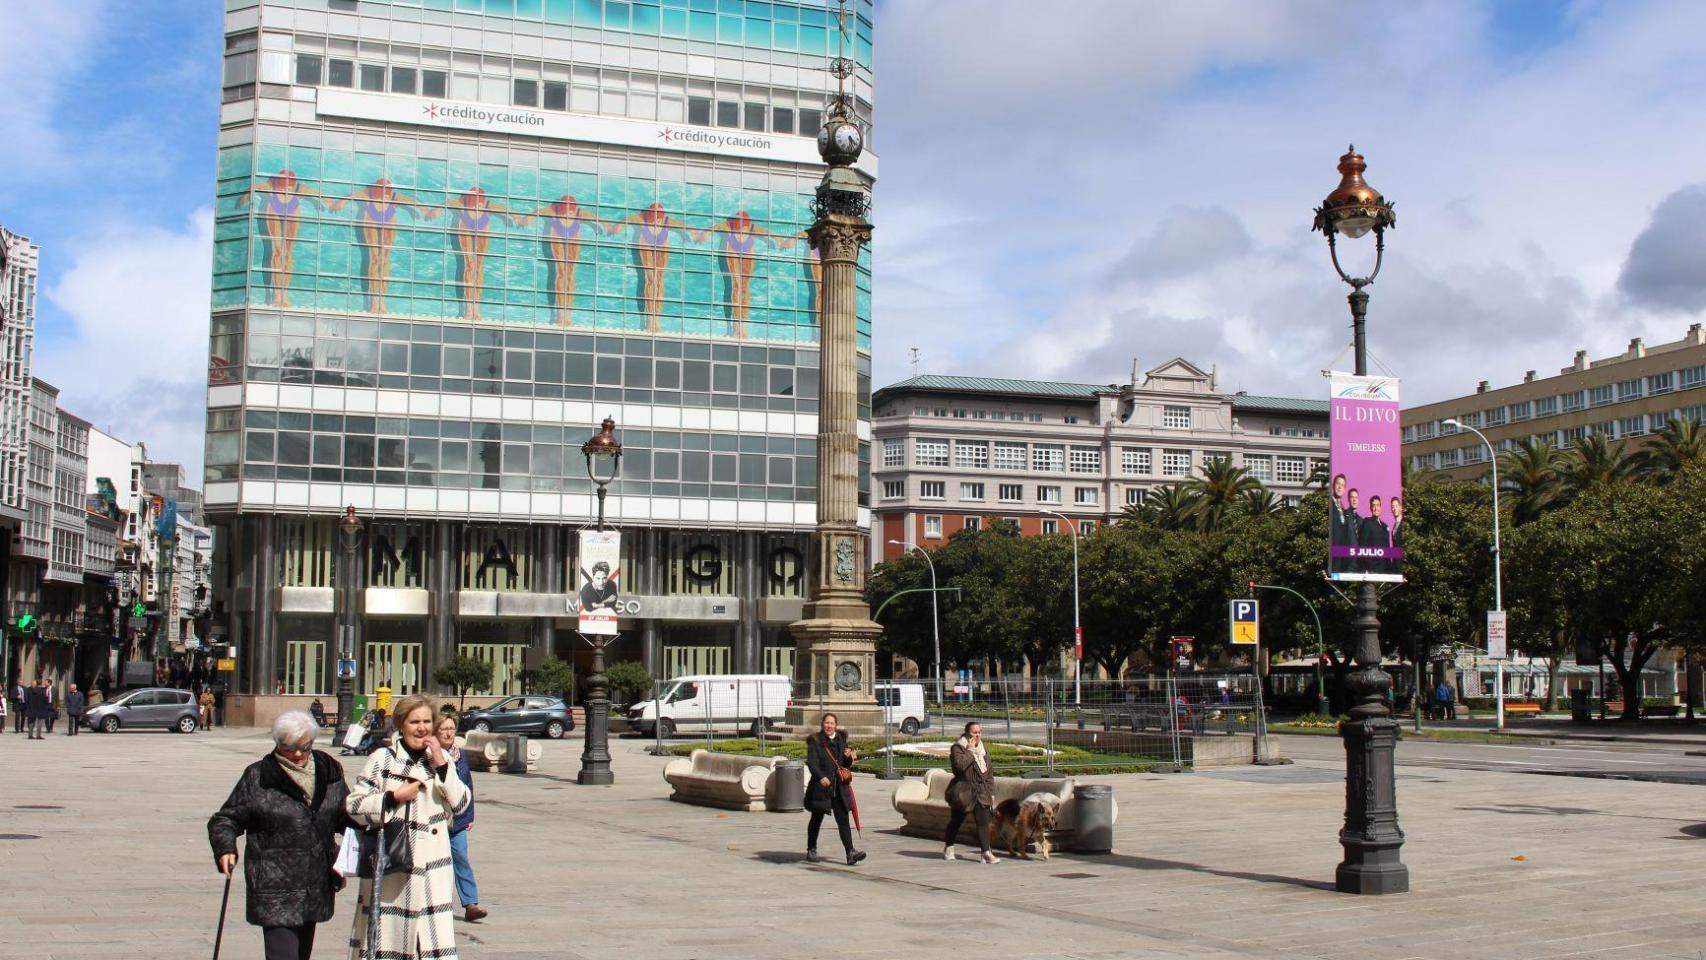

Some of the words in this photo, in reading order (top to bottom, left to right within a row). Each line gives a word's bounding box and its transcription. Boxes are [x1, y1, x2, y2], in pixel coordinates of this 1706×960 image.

[440, 105, 486, 120] crédito
[488, 112, 495, 124] y
[496, 112, 545, 126] caución
[673, 130, 717, 144] crédito
[717, 137, 725, 147] y
[726, 136, 771, 149] caución
[1335, 406, 1351, 420] IL
[1356, 406, 1397, 423] DIVO
[1347, 442, 1386, 453] TIMELESS
[1349, 547, 1356, 556] 5
[1357, 548, 1384, 557] JULIO
[1238, 602, 1251, 620] P
